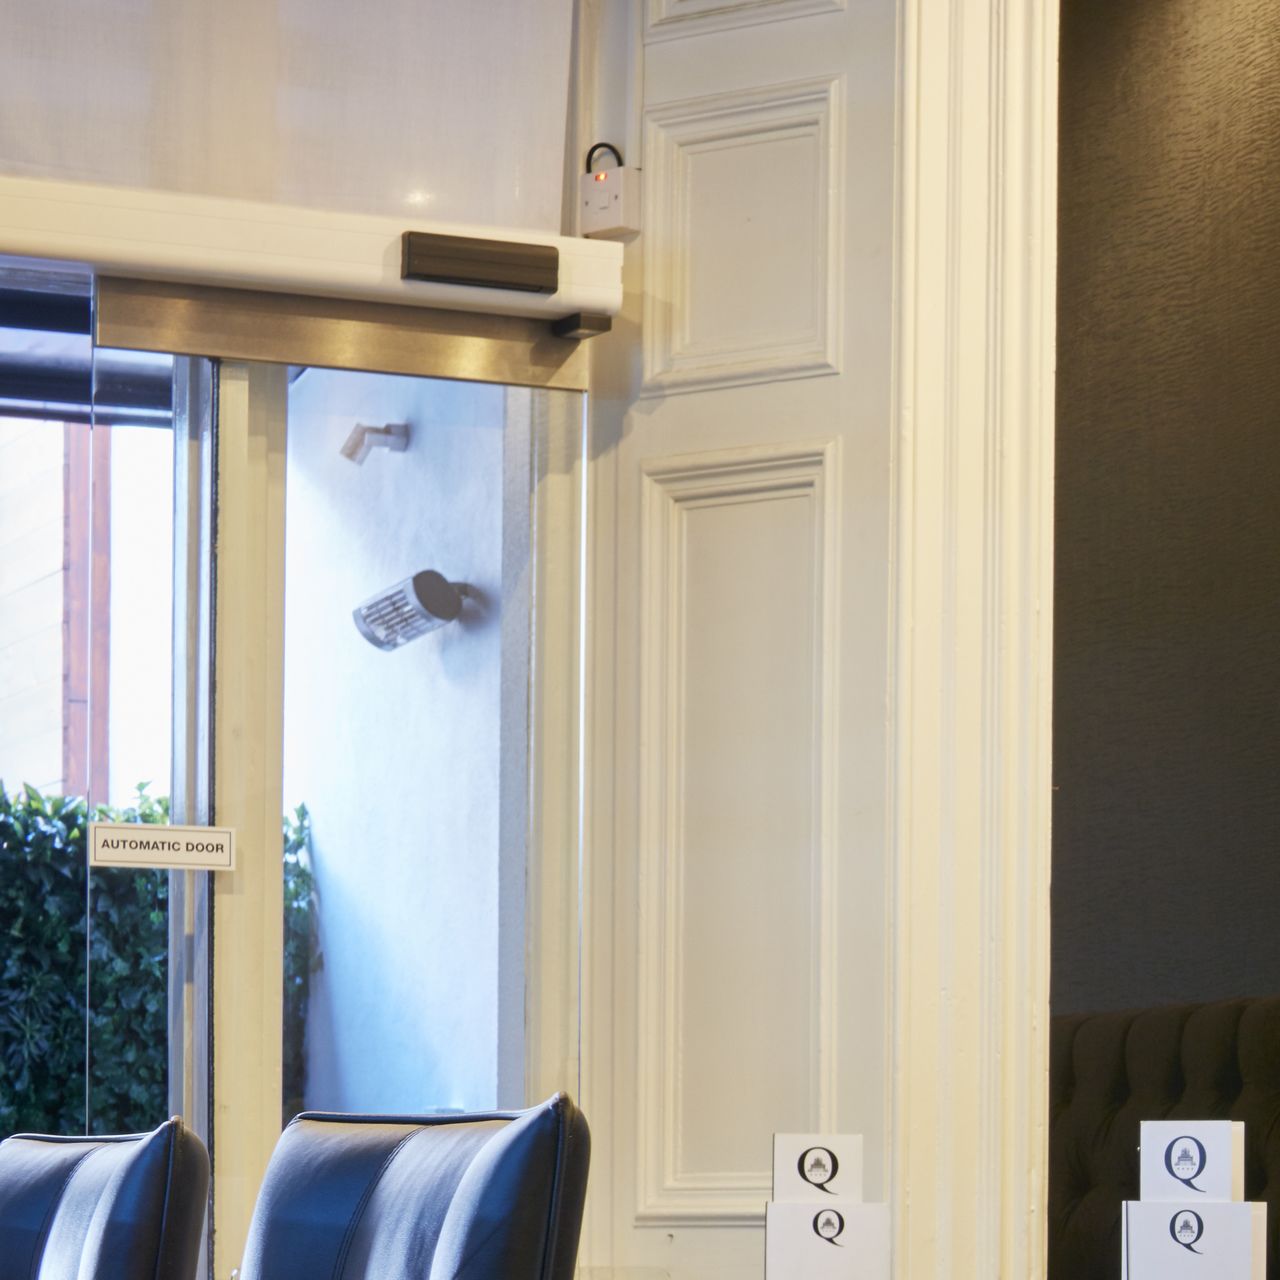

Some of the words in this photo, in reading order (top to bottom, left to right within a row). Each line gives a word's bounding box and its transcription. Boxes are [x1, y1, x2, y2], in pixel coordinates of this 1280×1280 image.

[101, 839, 181, 852] AUTOMATIC
[185, 842, 224, 853] DOOR
[797, 1146, 840, 1196] Q
[1163, 1135, 1208, 1193] Q
[811, 1208, 846, 1248] Q
[1168, 1209, 1205, 1255] Q
